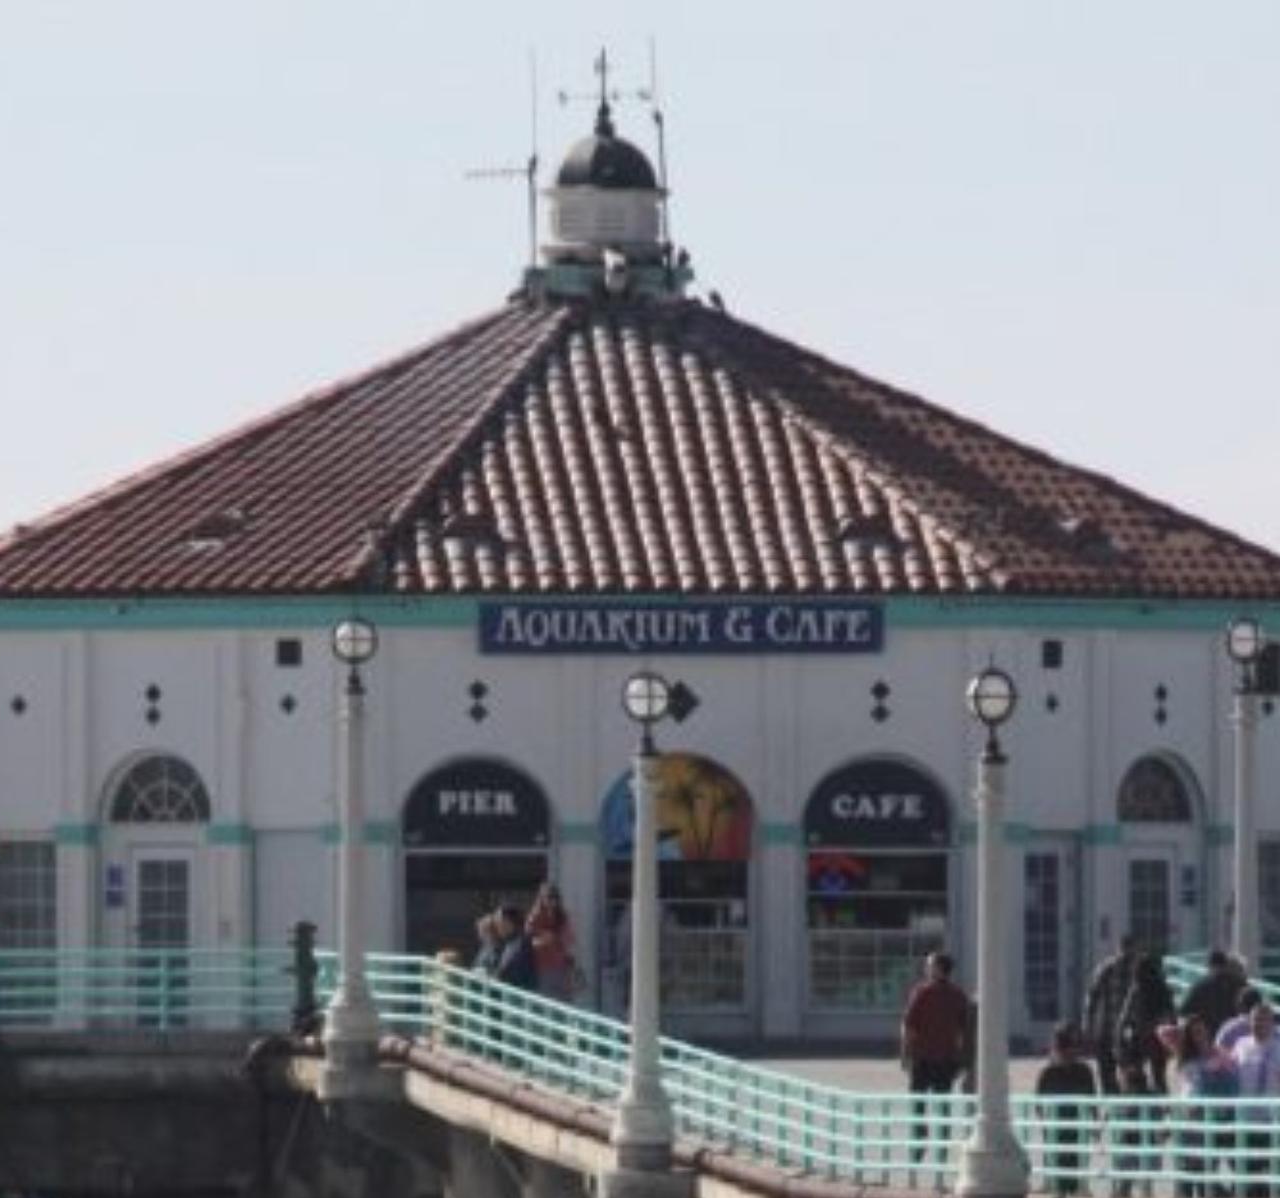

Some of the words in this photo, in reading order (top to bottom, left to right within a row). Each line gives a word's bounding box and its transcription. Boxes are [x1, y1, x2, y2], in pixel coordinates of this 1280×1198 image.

[496, 605, 711, 650] AQUARIUM
[723, 606, 753, 643] &
[765, 605, 871, 643] CAFE
[438, 789, 518, 816] PIER
[831, 793, 925, 819] CAFE
